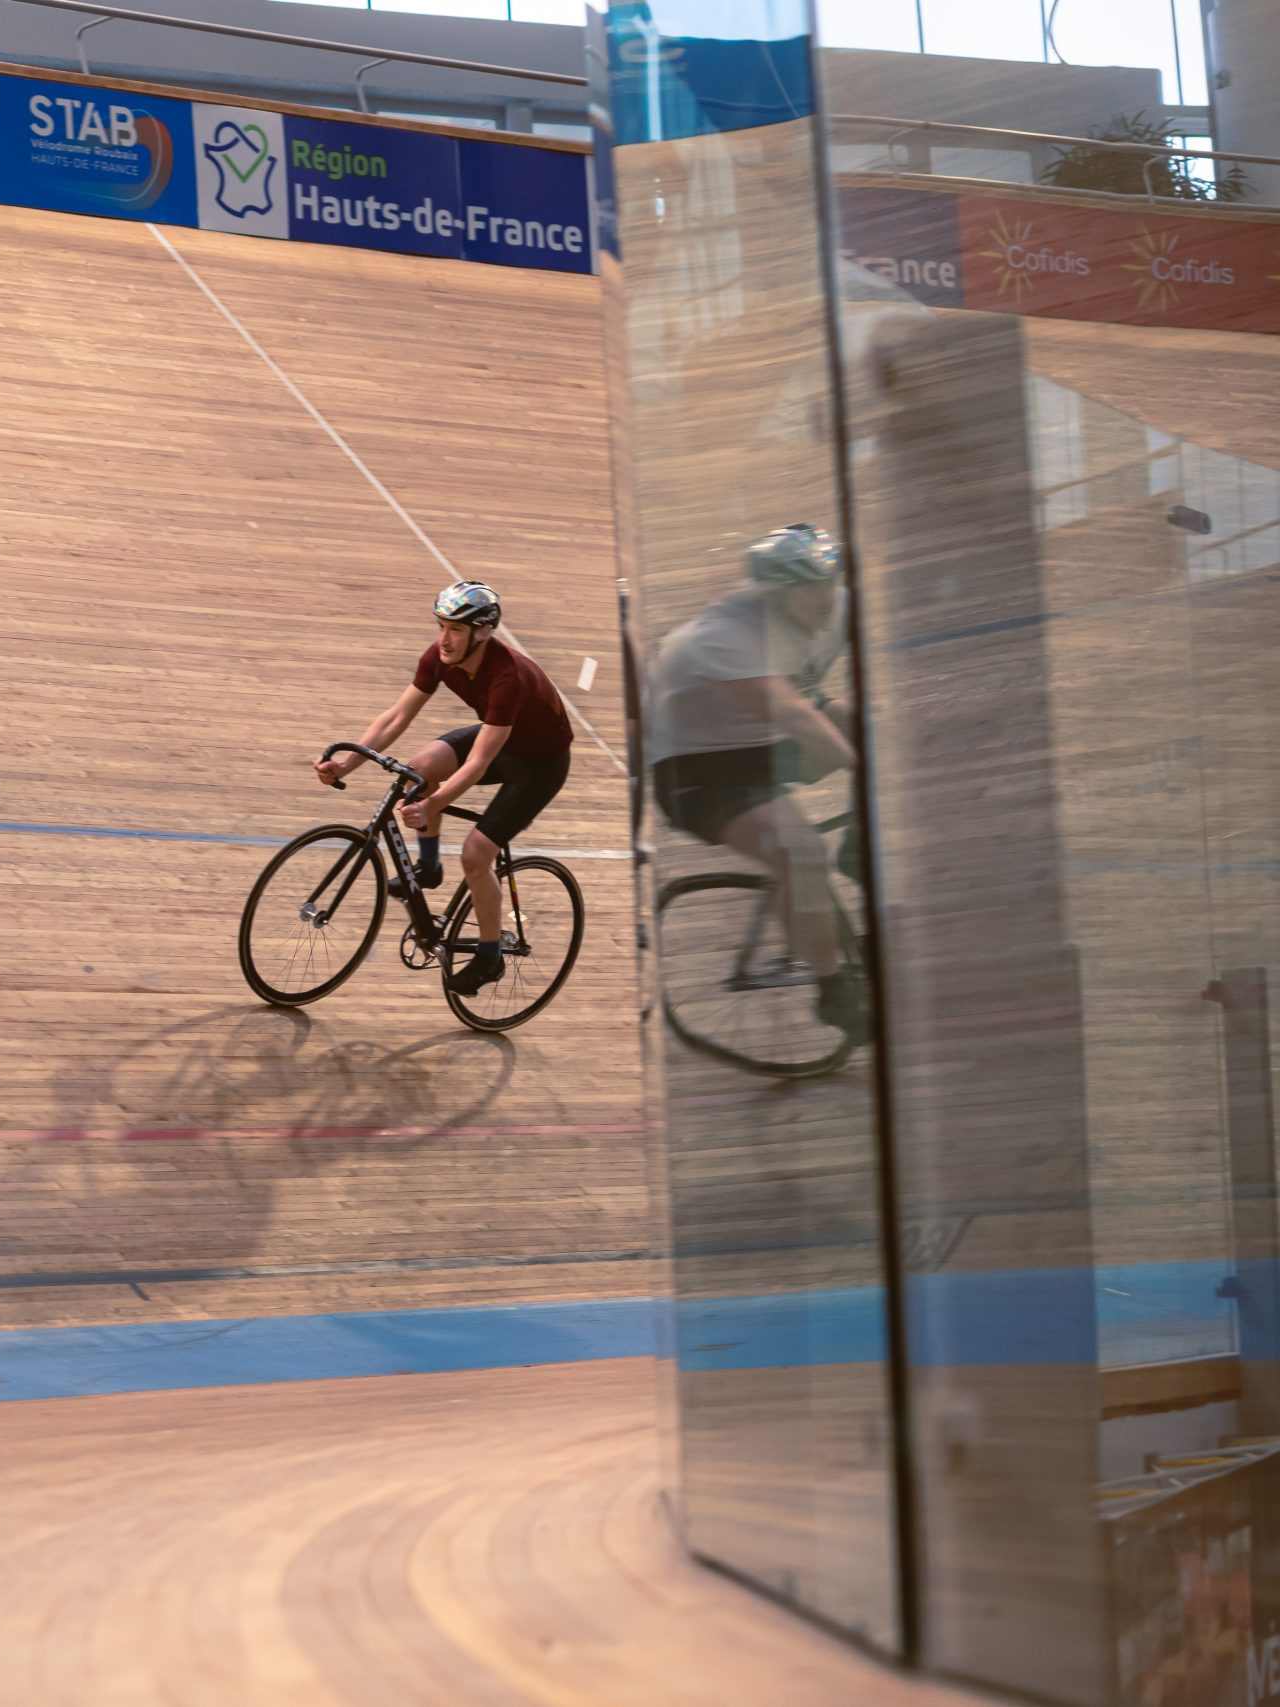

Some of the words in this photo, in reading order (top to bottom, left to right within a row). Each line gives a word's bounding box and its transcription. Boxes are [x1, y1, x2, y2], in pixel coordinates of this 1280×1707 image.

[29, 94, 137, 147] STAB
[31, 153, 139, 176] HAUTS-DE-FRANCE
[94, 146, 138, 161] Roubaix
[291, 139, 388, 180] Région
[294, 183, 583, 253] Hauts-de-France
[1006, 245, 1090, 276] Cofidis
[1151, 256, 1235, 285] Cofidis
[387, 819, 420, 894] LOOK
